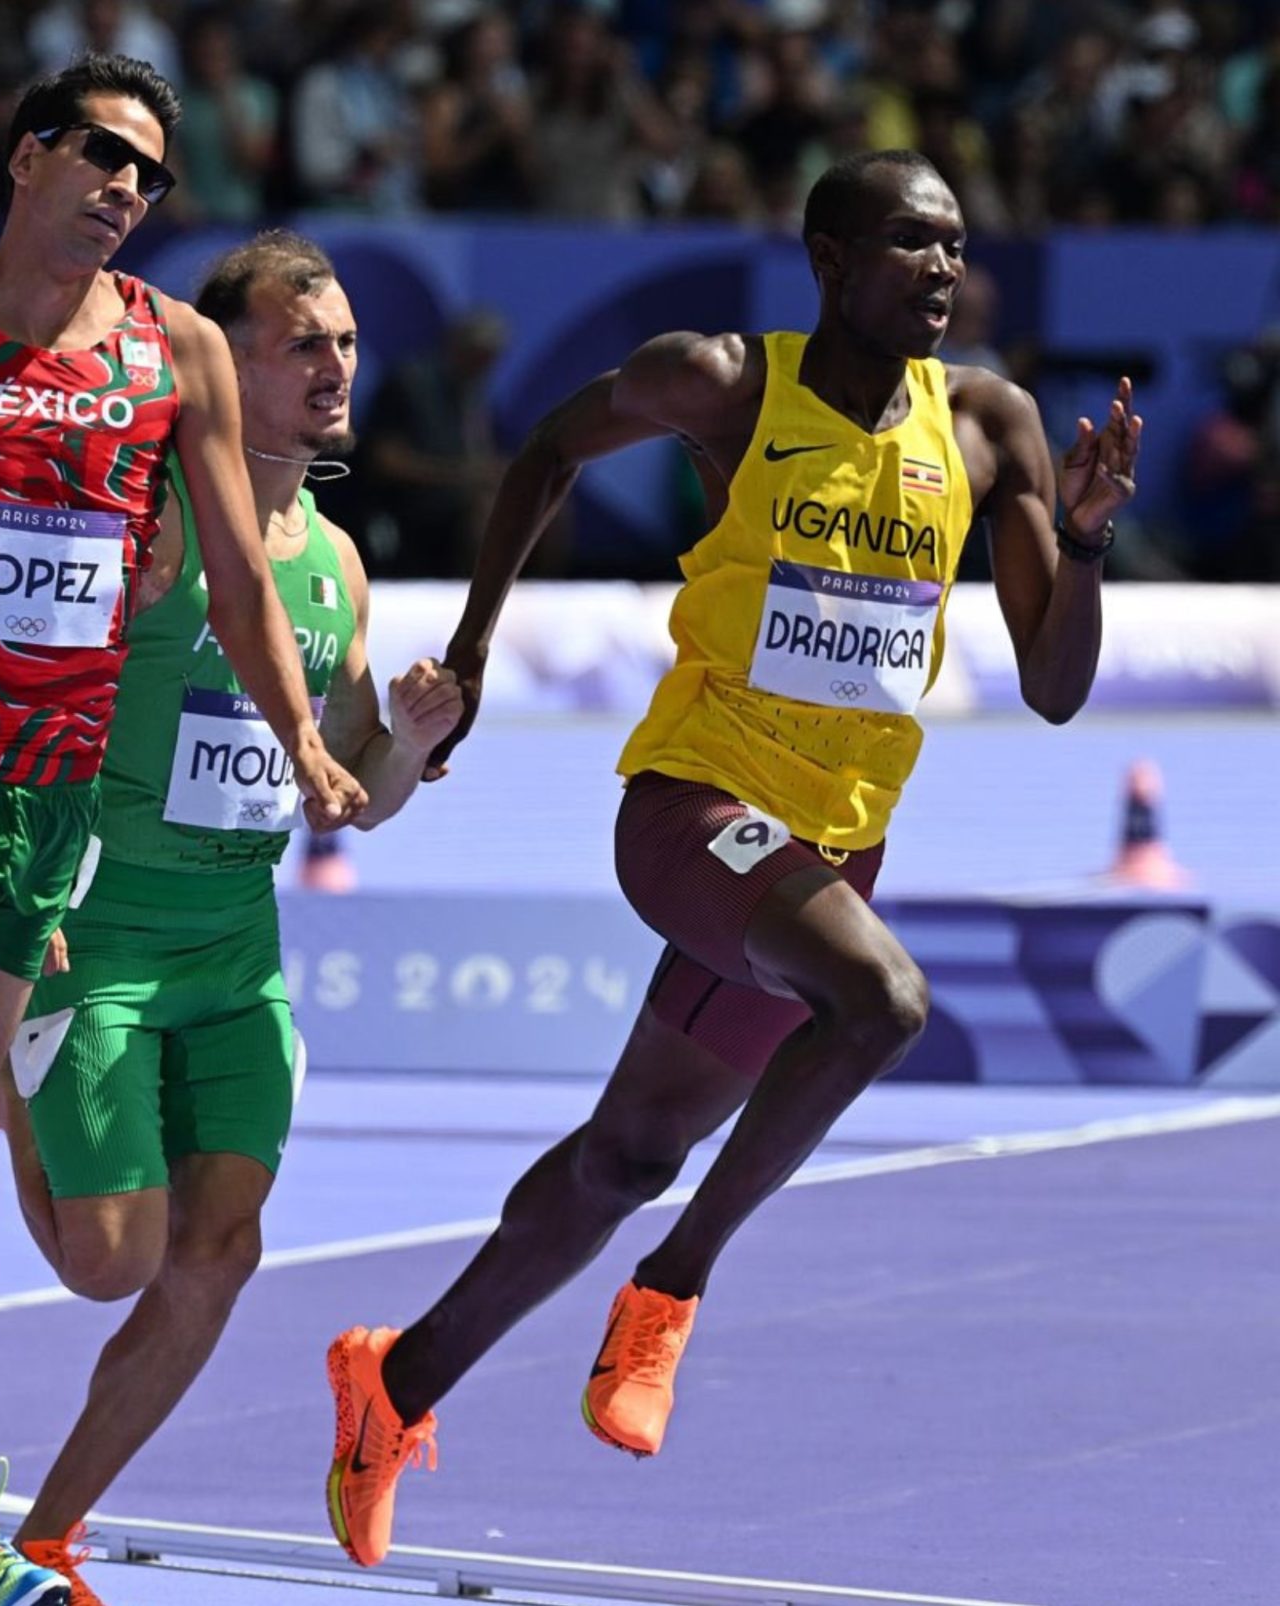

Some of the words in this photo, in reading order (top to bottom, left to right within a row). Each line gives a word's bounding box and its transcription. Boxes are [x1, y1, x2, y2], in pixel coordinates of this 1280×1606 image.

[46, 515, 87, 530] 2024
[772, 497, 936, 566] UGANDA
[822, 574, 868, 594] PARIS
[874, 583, 910, 599] 2024
[765, 610, 924, 669] DRADRIGA
[233, 700, 257, 714] PAR
[735, 821, 769, 848] 9
[395, 951, 628, 1014] 2024
